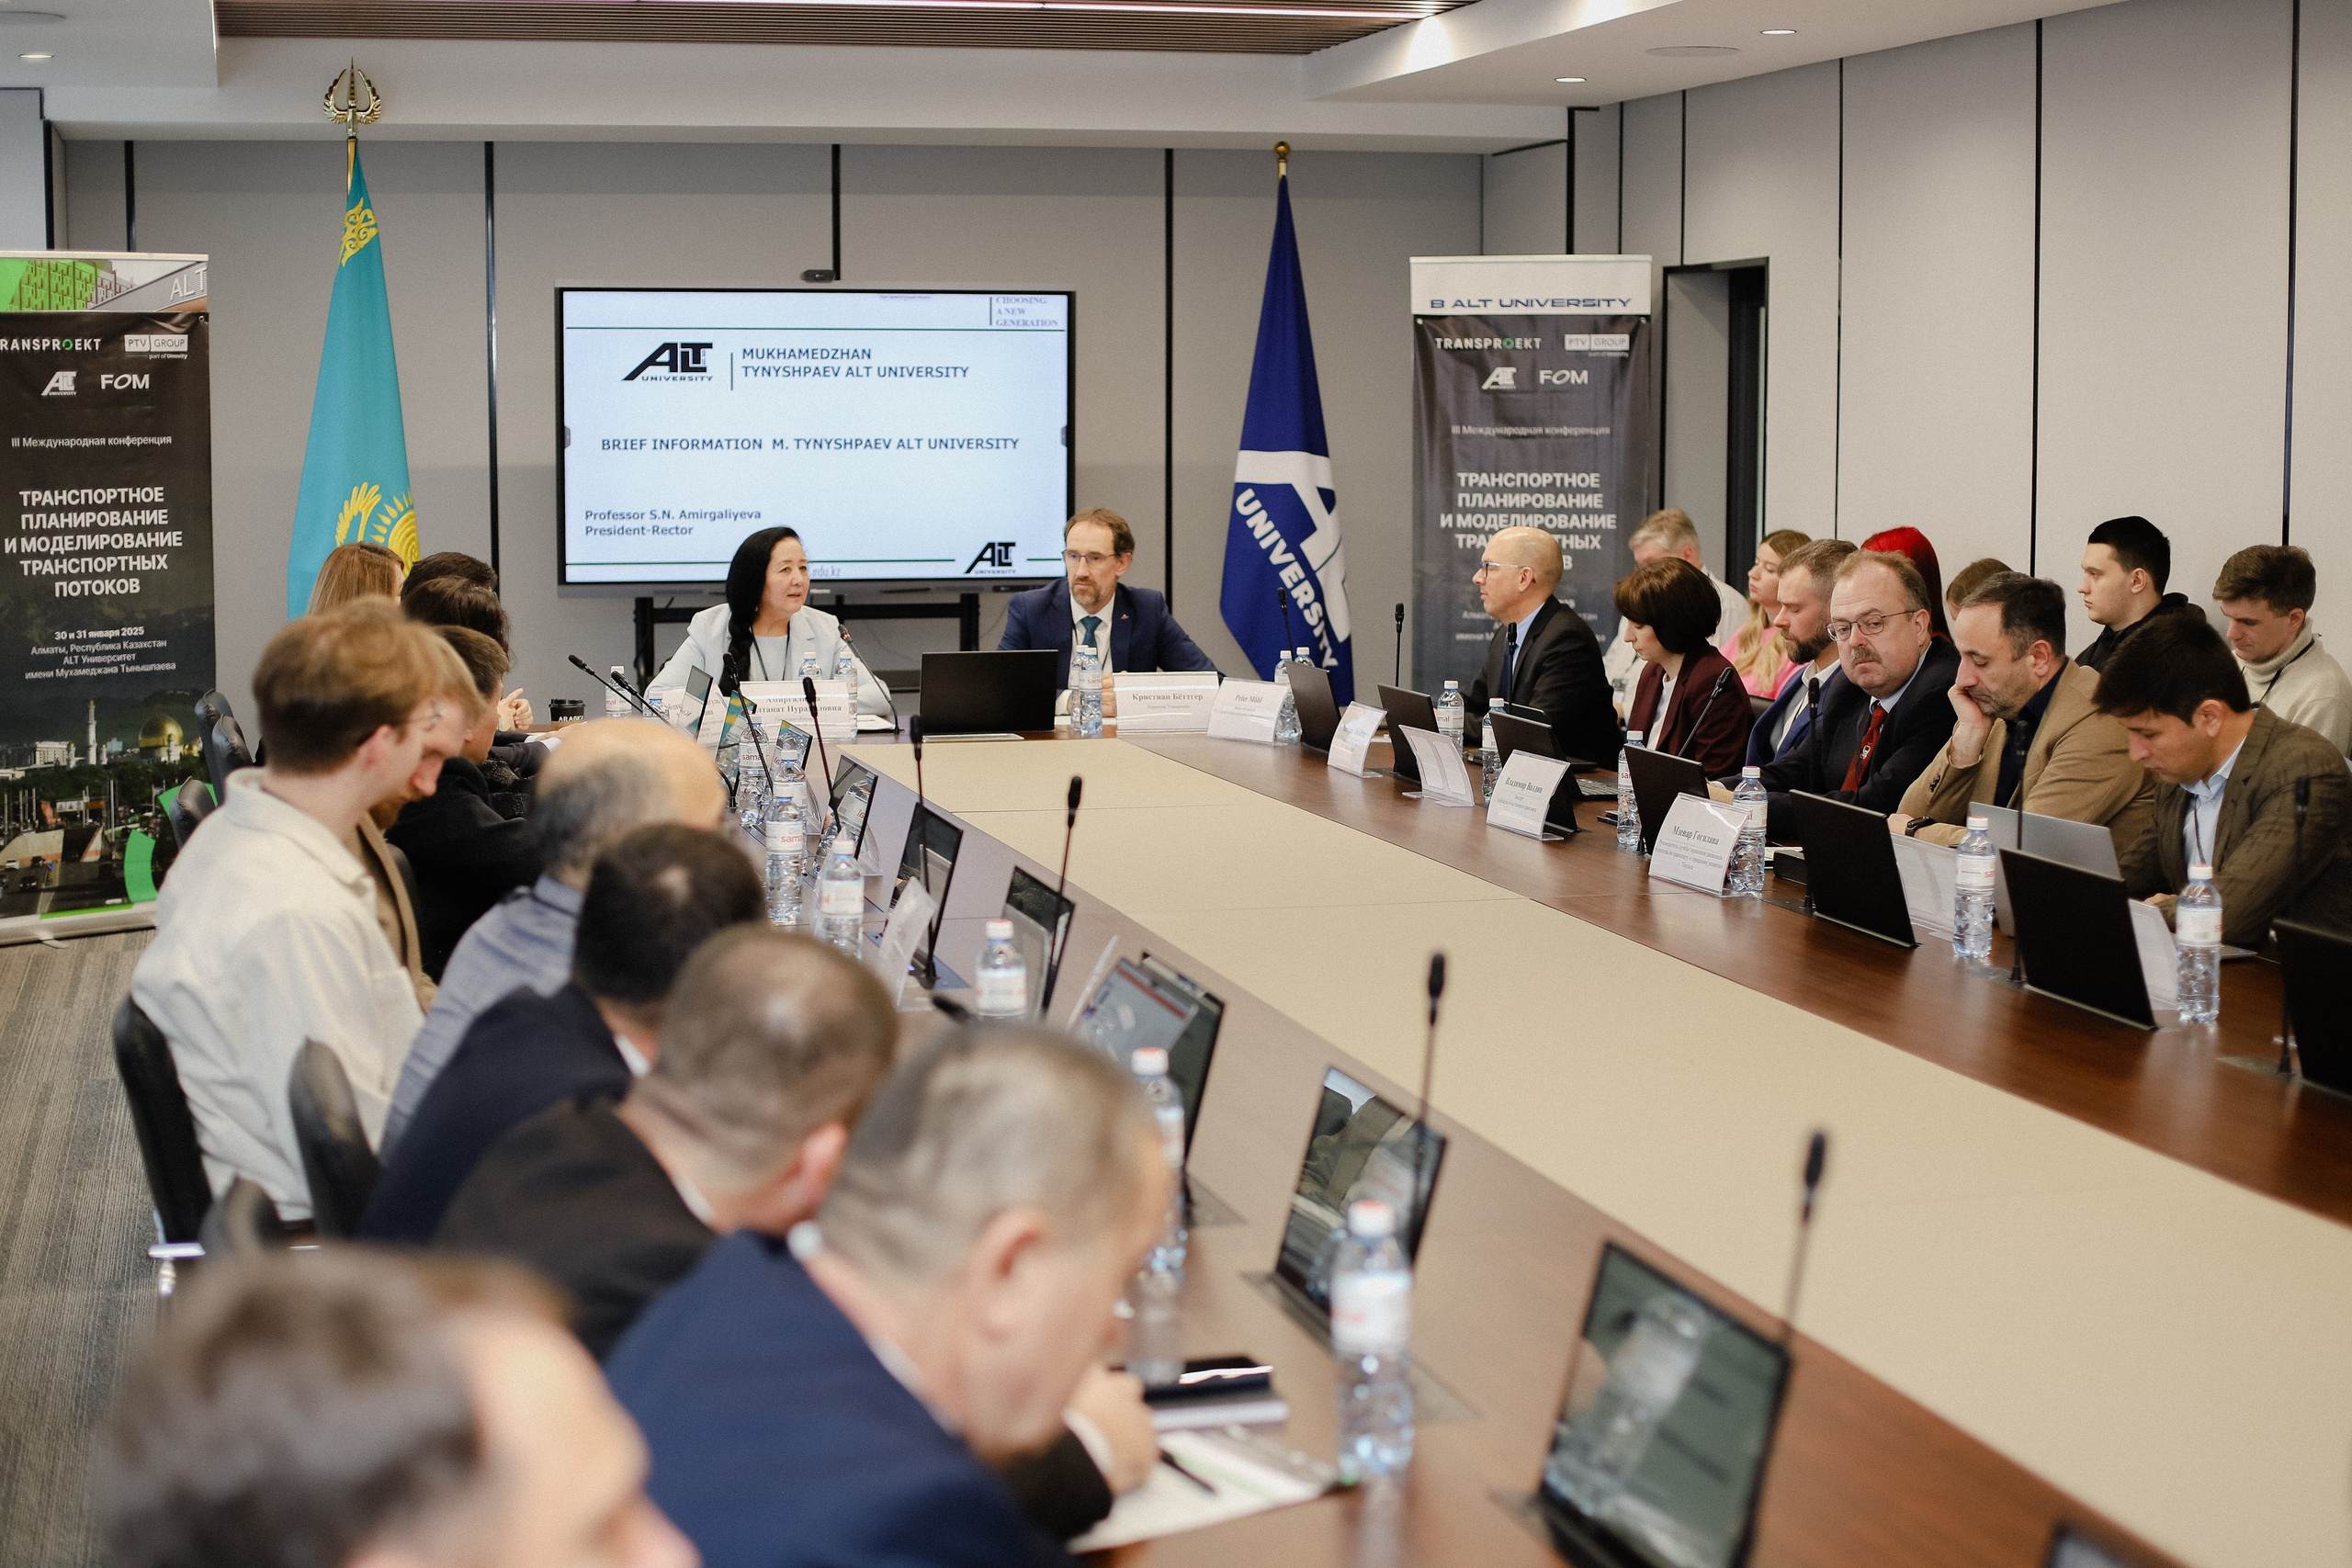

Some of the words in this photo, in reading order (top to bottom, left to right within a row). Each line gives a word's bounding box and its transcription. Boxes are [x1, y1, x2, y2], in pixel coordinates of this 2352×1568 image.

[170, 266, 207, 300] ALT
[996, 296, 1046, 305] CHOOSING
[1453, 299, 1492, 308] ALT
[1499, 299, 1632, 308] UNIVERSITY
[996, 308, 1003, 316] A
[1004, 308, 1026, 316] NEW
[996, 319, 1057, 327] GENERATION
[0, 338, 101, 352] RANSPROEKT
[128, 339, 147, 348] PTV
[153, 338, 186, 348] GROUP
[1434, 337, 1542, 350] TRANSPROEKT
[1567, 338, 1588, 347] PTV
[1594, 338, 1626, 347] GROUP
[742, 348, 871, 360] MUKHAMEDZHAN
[621, 342, 713, 381] ALT
[741, 366, 841, 378] TYNYSHPAEV
[845, 367, 872, 378] ALT
[877, 367, 969, 378] UNIVERSITY
[1539, 369, 1589, 385] FOM
[40, 371, 77, 396] ALT
[100, 373, 150, 389] FOM
[22, 436, 106, 449] Международная
[107, 435, 173, 447] конференция
[601, 438, 648, 450] BRIEF
[651, 438, 763, 450] INFORMATION
[773, 438, 789, 450] M.
[794, 438, 892, 450] TYNYSHPAEV
[897, 438, 923, 450] ALT
[928, 438, 1019, 450] UNIVERSITY
[1456, 472, 1601, 488] ТРАНСПОРТНОЕ
[19, 487, 164, 506] ТРАНСПОРТНОЕ
[1457, 493, 1604, 509] ПЛАНИРОВАНИЕ
[20, 509, 169, 530] ПЛАНИРОВАНИЕ
[585, 509, 645, 520] Professor
[649, 509, 675, 520] S.N.
[679, 509, 762, 522] Amirgaliyeva
[1440, 513, 1453, 528] И
[1456, 513, 1617, 530] МОДЕЛИРОВАНИЕ
[585, 525, 694, 536] President-Rector
[5, 537, 17, 554] И
[20, 531, 183, 555] МОДЕЛИРОВАНИЕ
[19, 554, 169, 576] ТРАНСПОРТНЫХ
[964, 542, 1016, 574] ALT
[54, 578, 141, 597] ПОТОКОВ
[54, 630, 67, 640] 30
[68, 632, 75, 640] и
[75, 629, 86, 639] 31
[87, 629, 120, 640] января
[120, 626, 145, 637] 2025
[30, 645, 69, 656] Алматы,
[70, 642, 121, 654] Республика
[122, 638, 167, 650] Казахстан
[81, 652, 136, 665] Университет
[25, 670, 54, 680] имени
[55, 666, 119, 679] Мухамеджана
[119, 661, 176, 674] Тынышпаева
[1132, 694, 1170, 702] Кристиан
